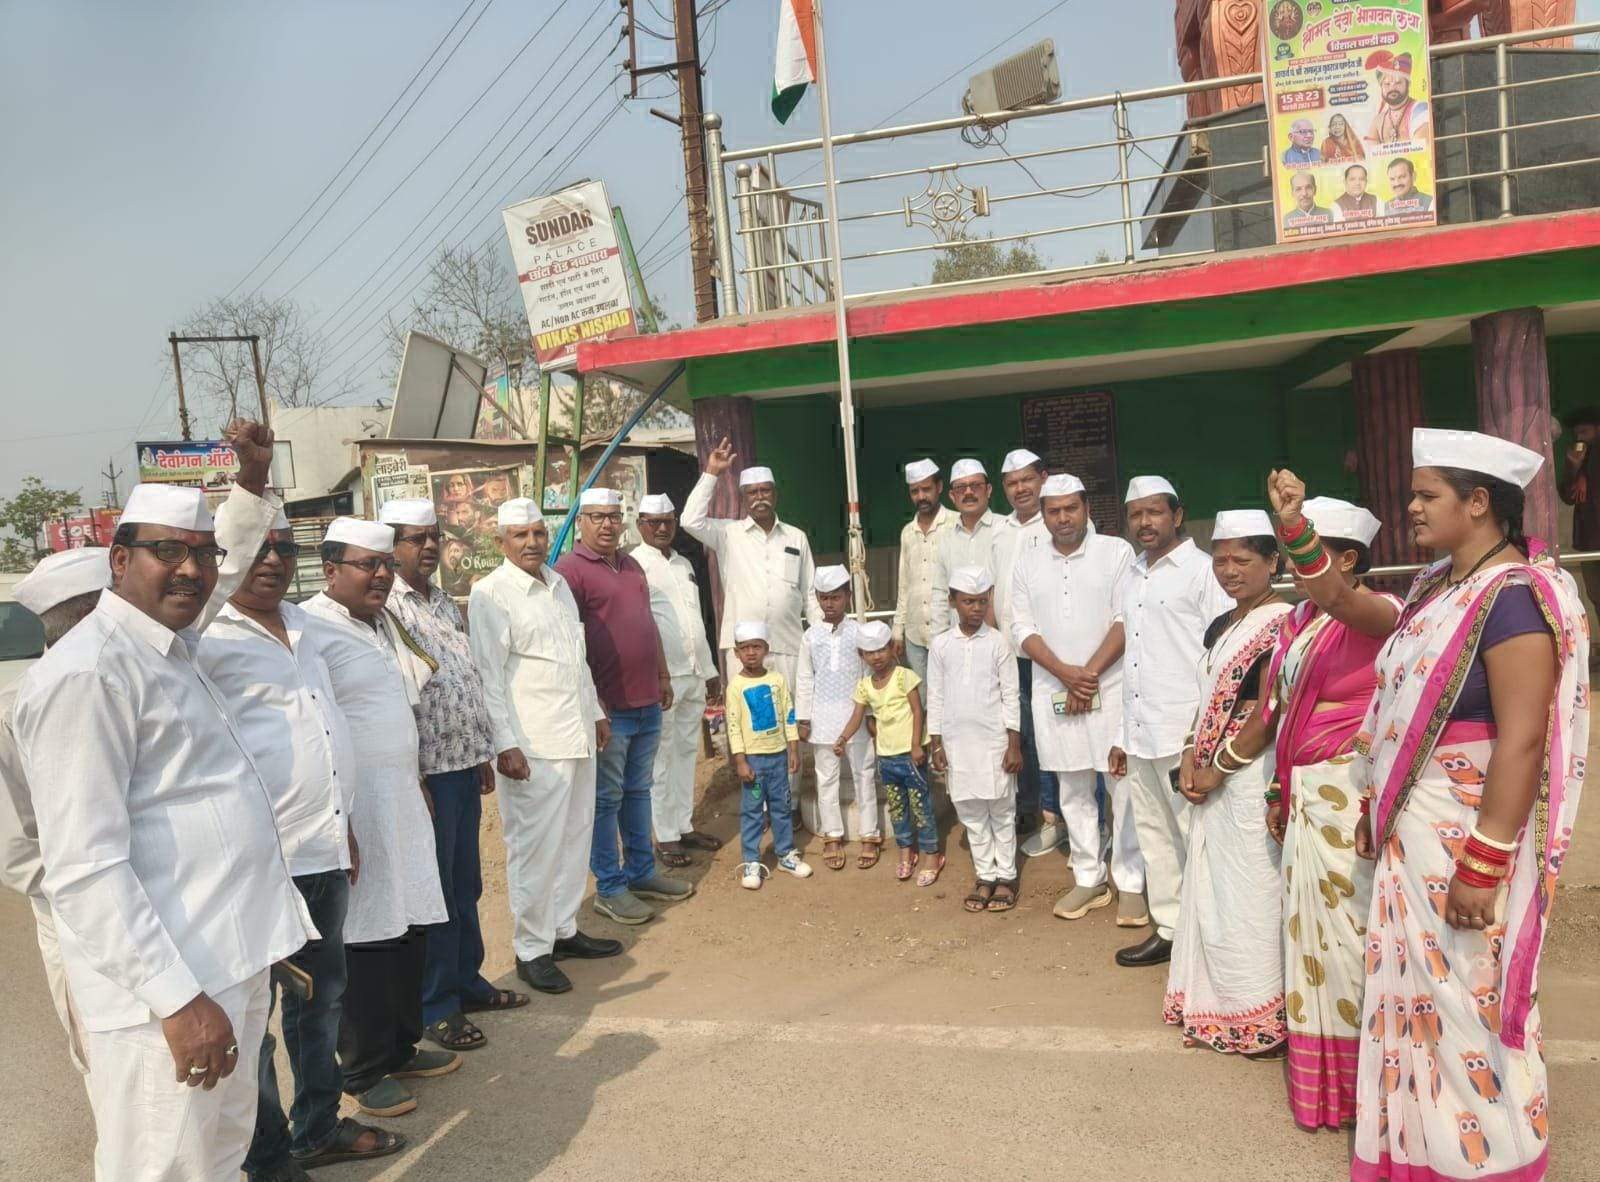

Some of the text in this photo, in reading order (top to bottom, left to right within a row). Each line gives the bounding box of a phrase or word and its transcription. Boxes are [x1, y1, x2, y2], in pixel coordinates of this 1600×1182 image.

[1396, 10, 1421, 30] कथा
[1281, 94, 1293, 104] 15
[1306, 90, 1319, 100] 23
[525, 209, 593, 245] SUNDAR
[533, 238, 599, 264] PALACE
[571, 310, 580, 320] AC
[537, 322, 580, 351] VIKAS
[580, 309, 631, 339] NISHAD
[158, 447, 235, 468] देवांगन ऑटो
